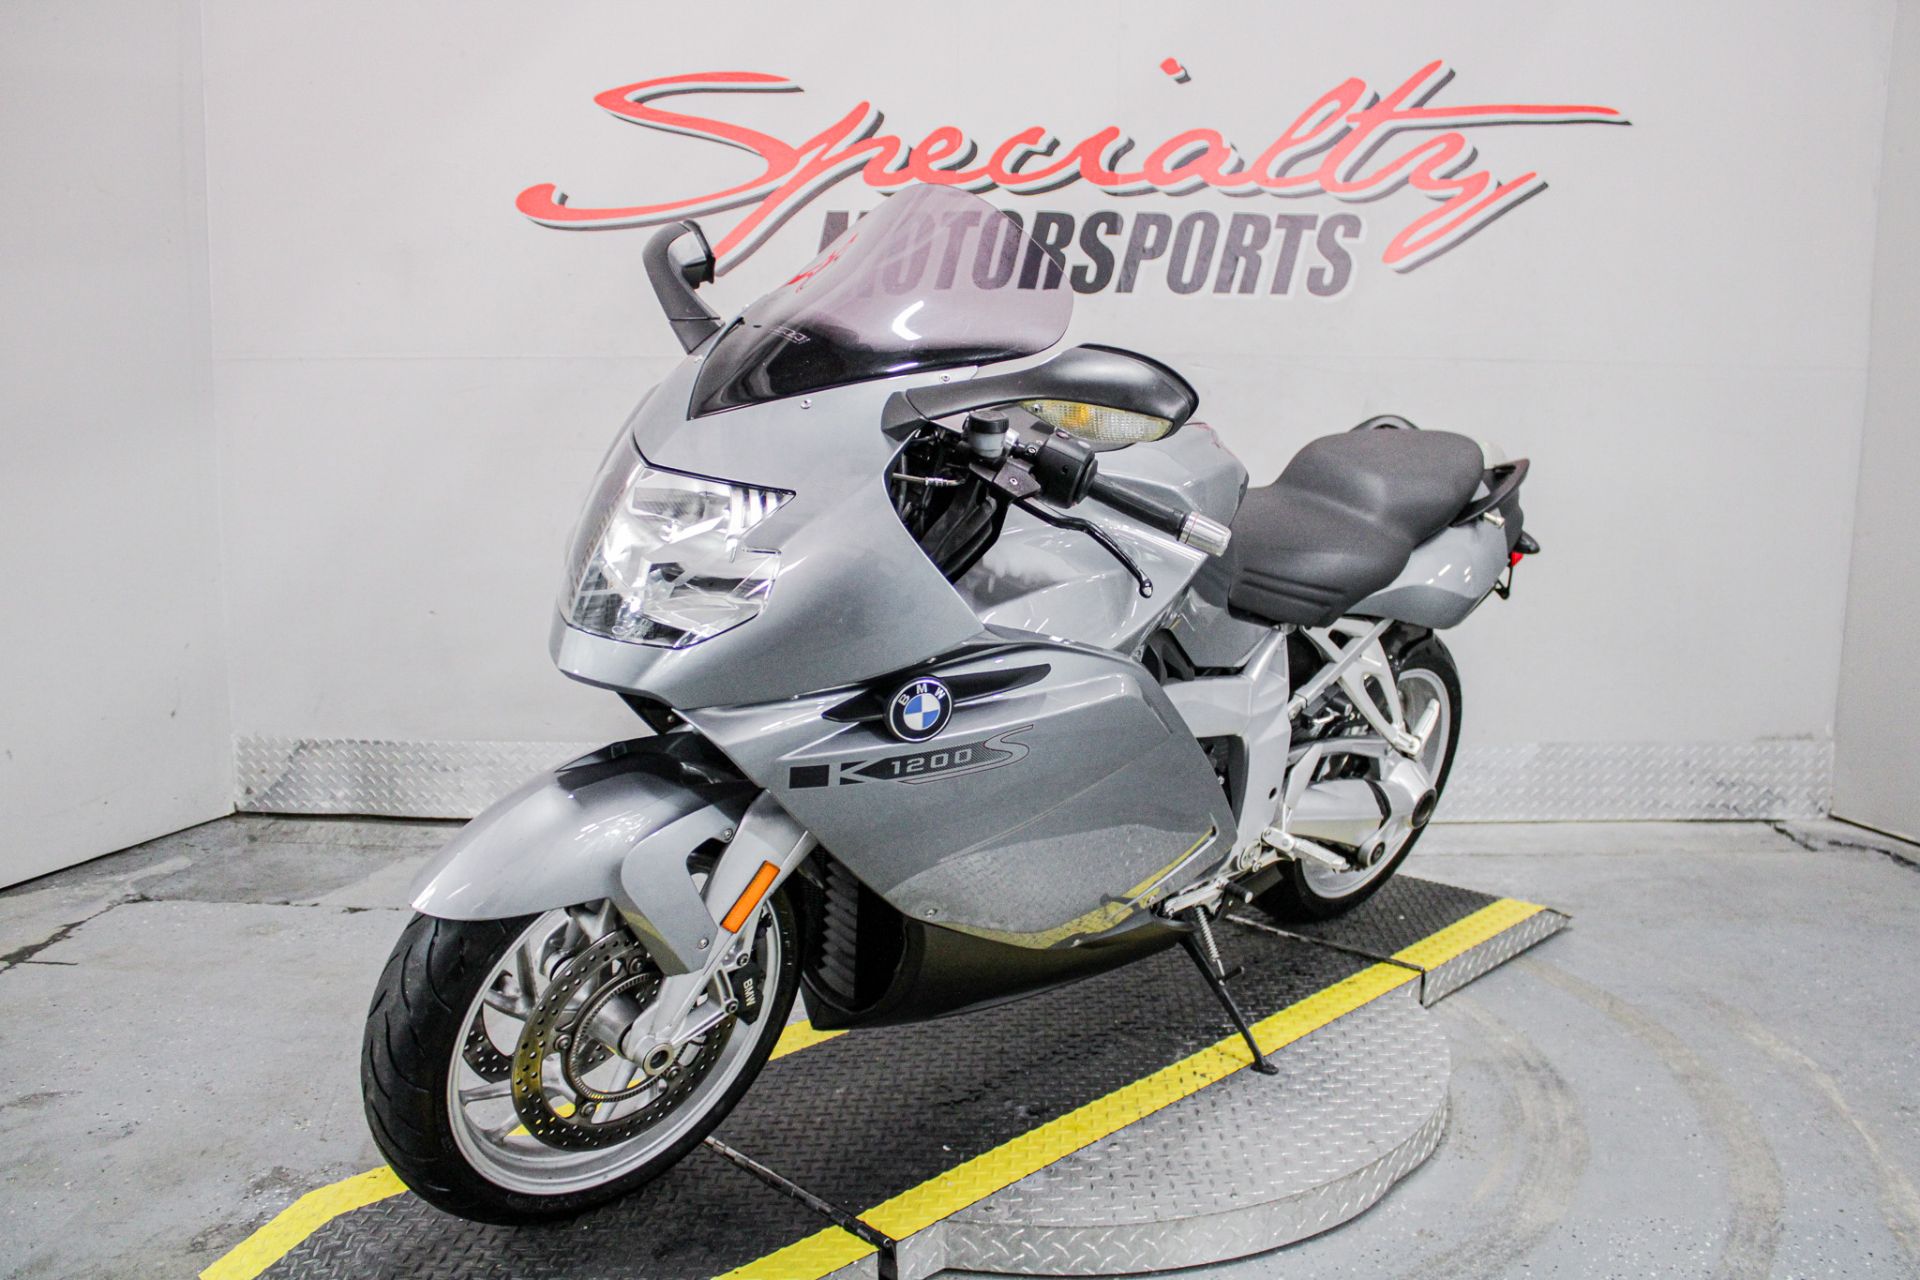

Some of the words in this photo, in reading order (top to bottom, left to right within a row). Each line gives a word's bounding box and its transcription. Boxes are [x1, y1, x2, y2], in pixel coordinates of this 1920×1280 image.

[515, 58, 1632, 275] Specialty
[898, 682, 946, 707] BMW
[891, 747, 973, 775] 1200
[743, 978, 756, 1006] BMW
